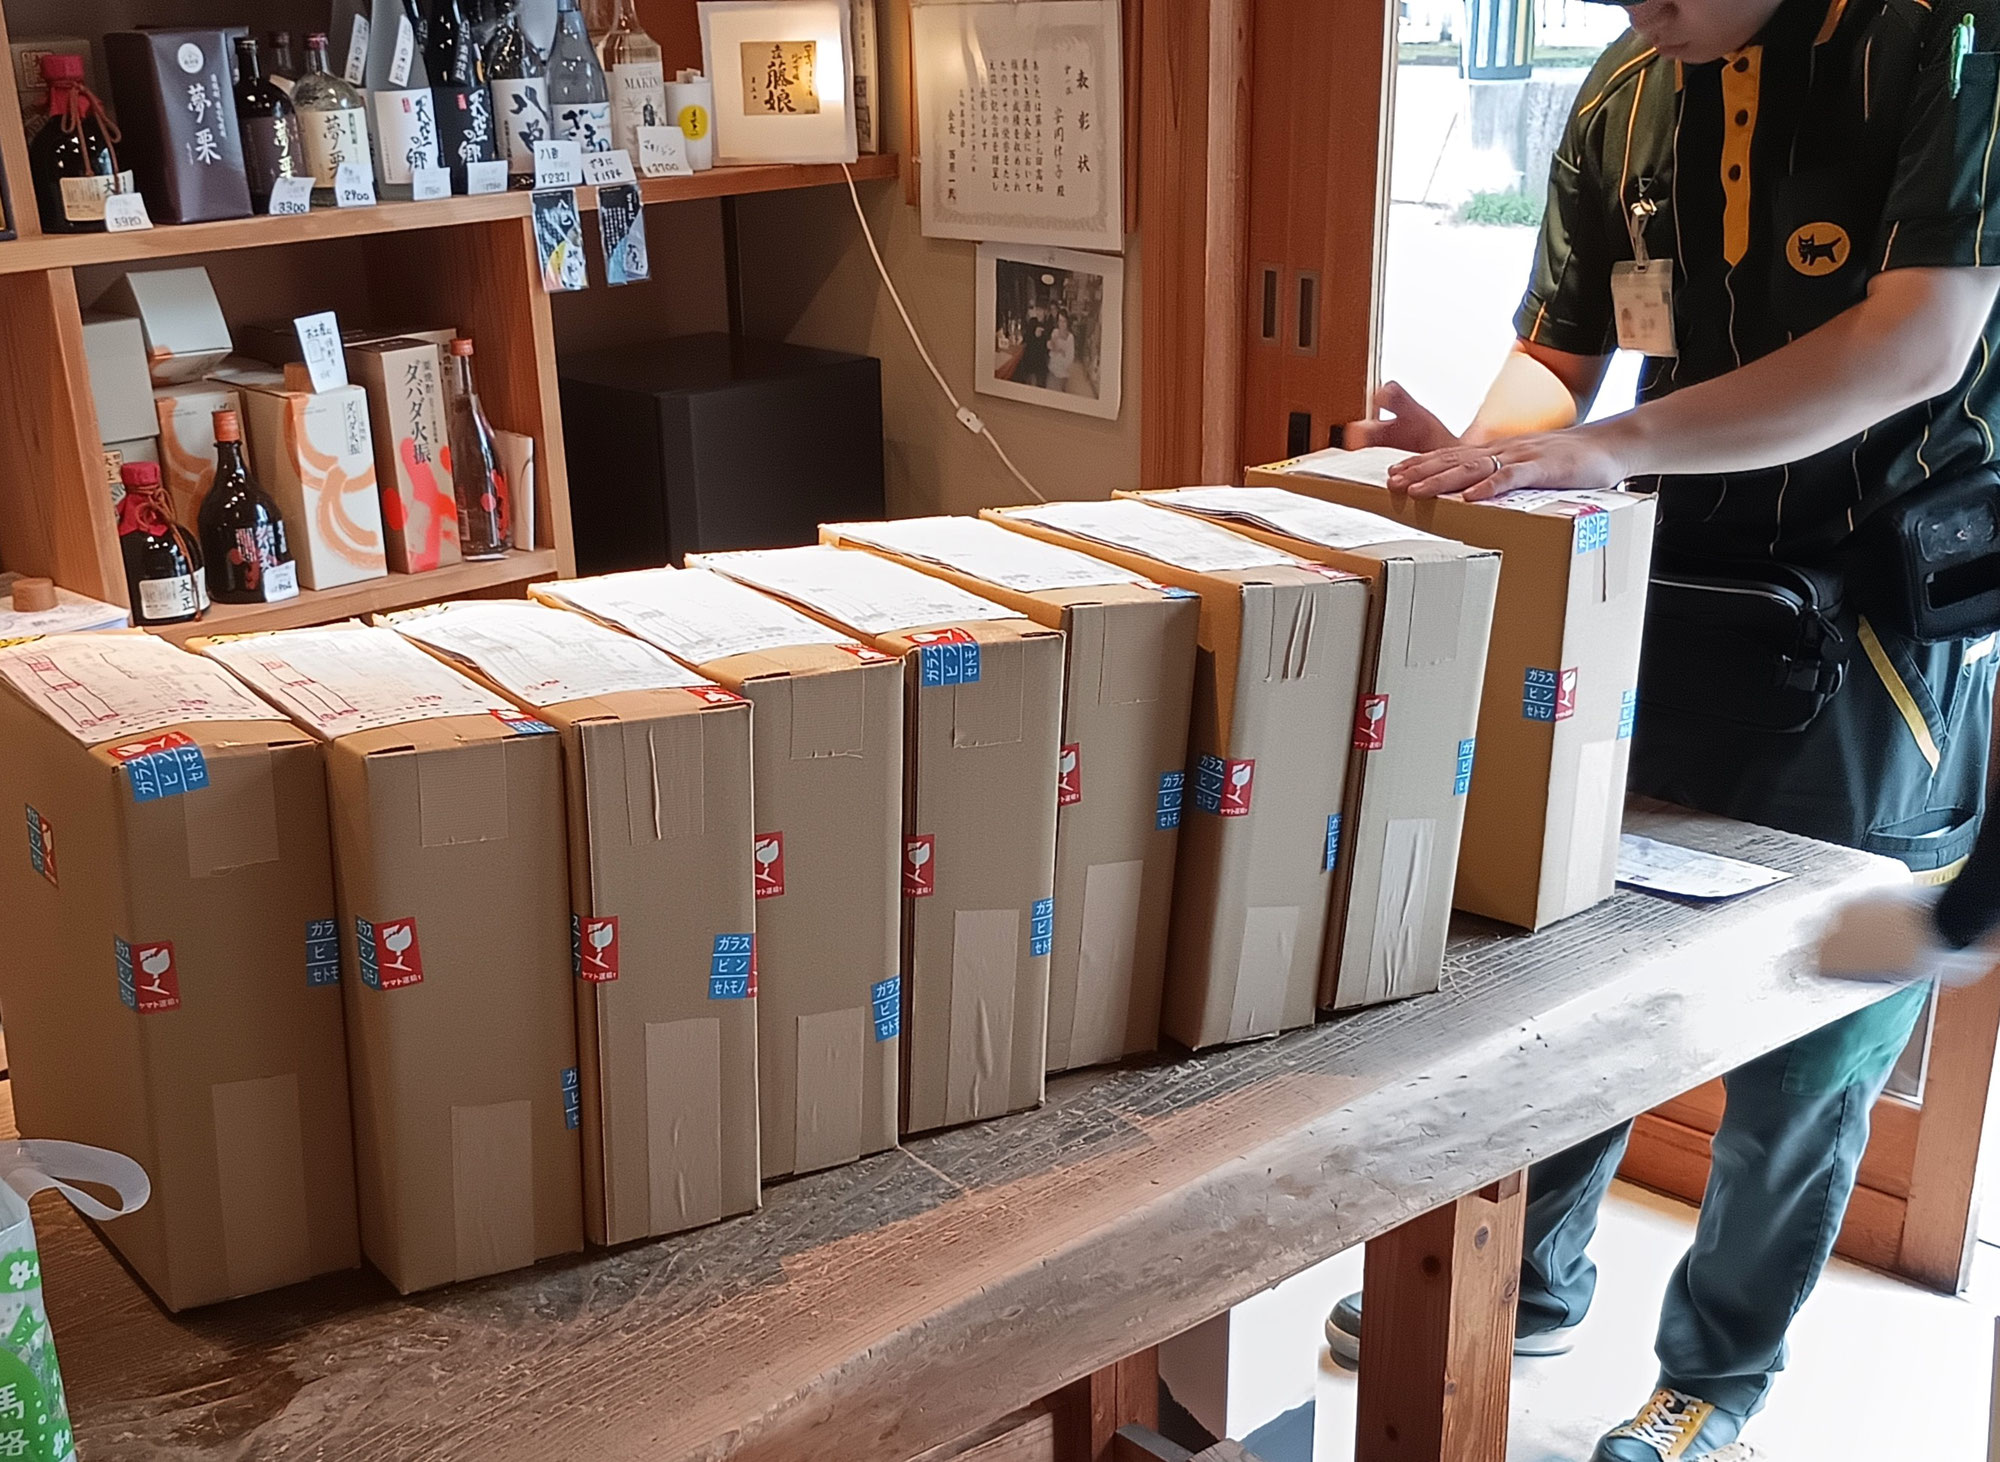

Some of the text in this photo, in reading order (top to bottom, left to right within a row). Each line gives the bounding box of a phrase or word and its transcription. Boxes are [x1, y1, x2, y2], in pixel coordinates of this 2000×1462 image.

[187, 83, 222, 165] 夢栗
[1076, 68, 1091, 173] 表彰状
[405, 360, 432, 464] ダバダ火振
[179, 578, 196, 611] 大正
[926, 645, 939, 681] ガラス
[945, 644, 958, 677] ビン
[963, 642, 978, 677] セトモノ
[1529, 669, 1555, 683] ガラス
[1529, 687, 1552, 700] ビン
[1527, 704, 1552, 719] セトモノ
[131, 756, 155, 795] ガラス
[157, 752, 179, 787] ビン
[180, 746, 205, 782] セトモノ
[1201, 755, 1225, 772] ガラス
[718, 936, 750, 951] ガラス
[718, 958, 747, 973] ビン
[714, 979, 746, 995] セトモノ
